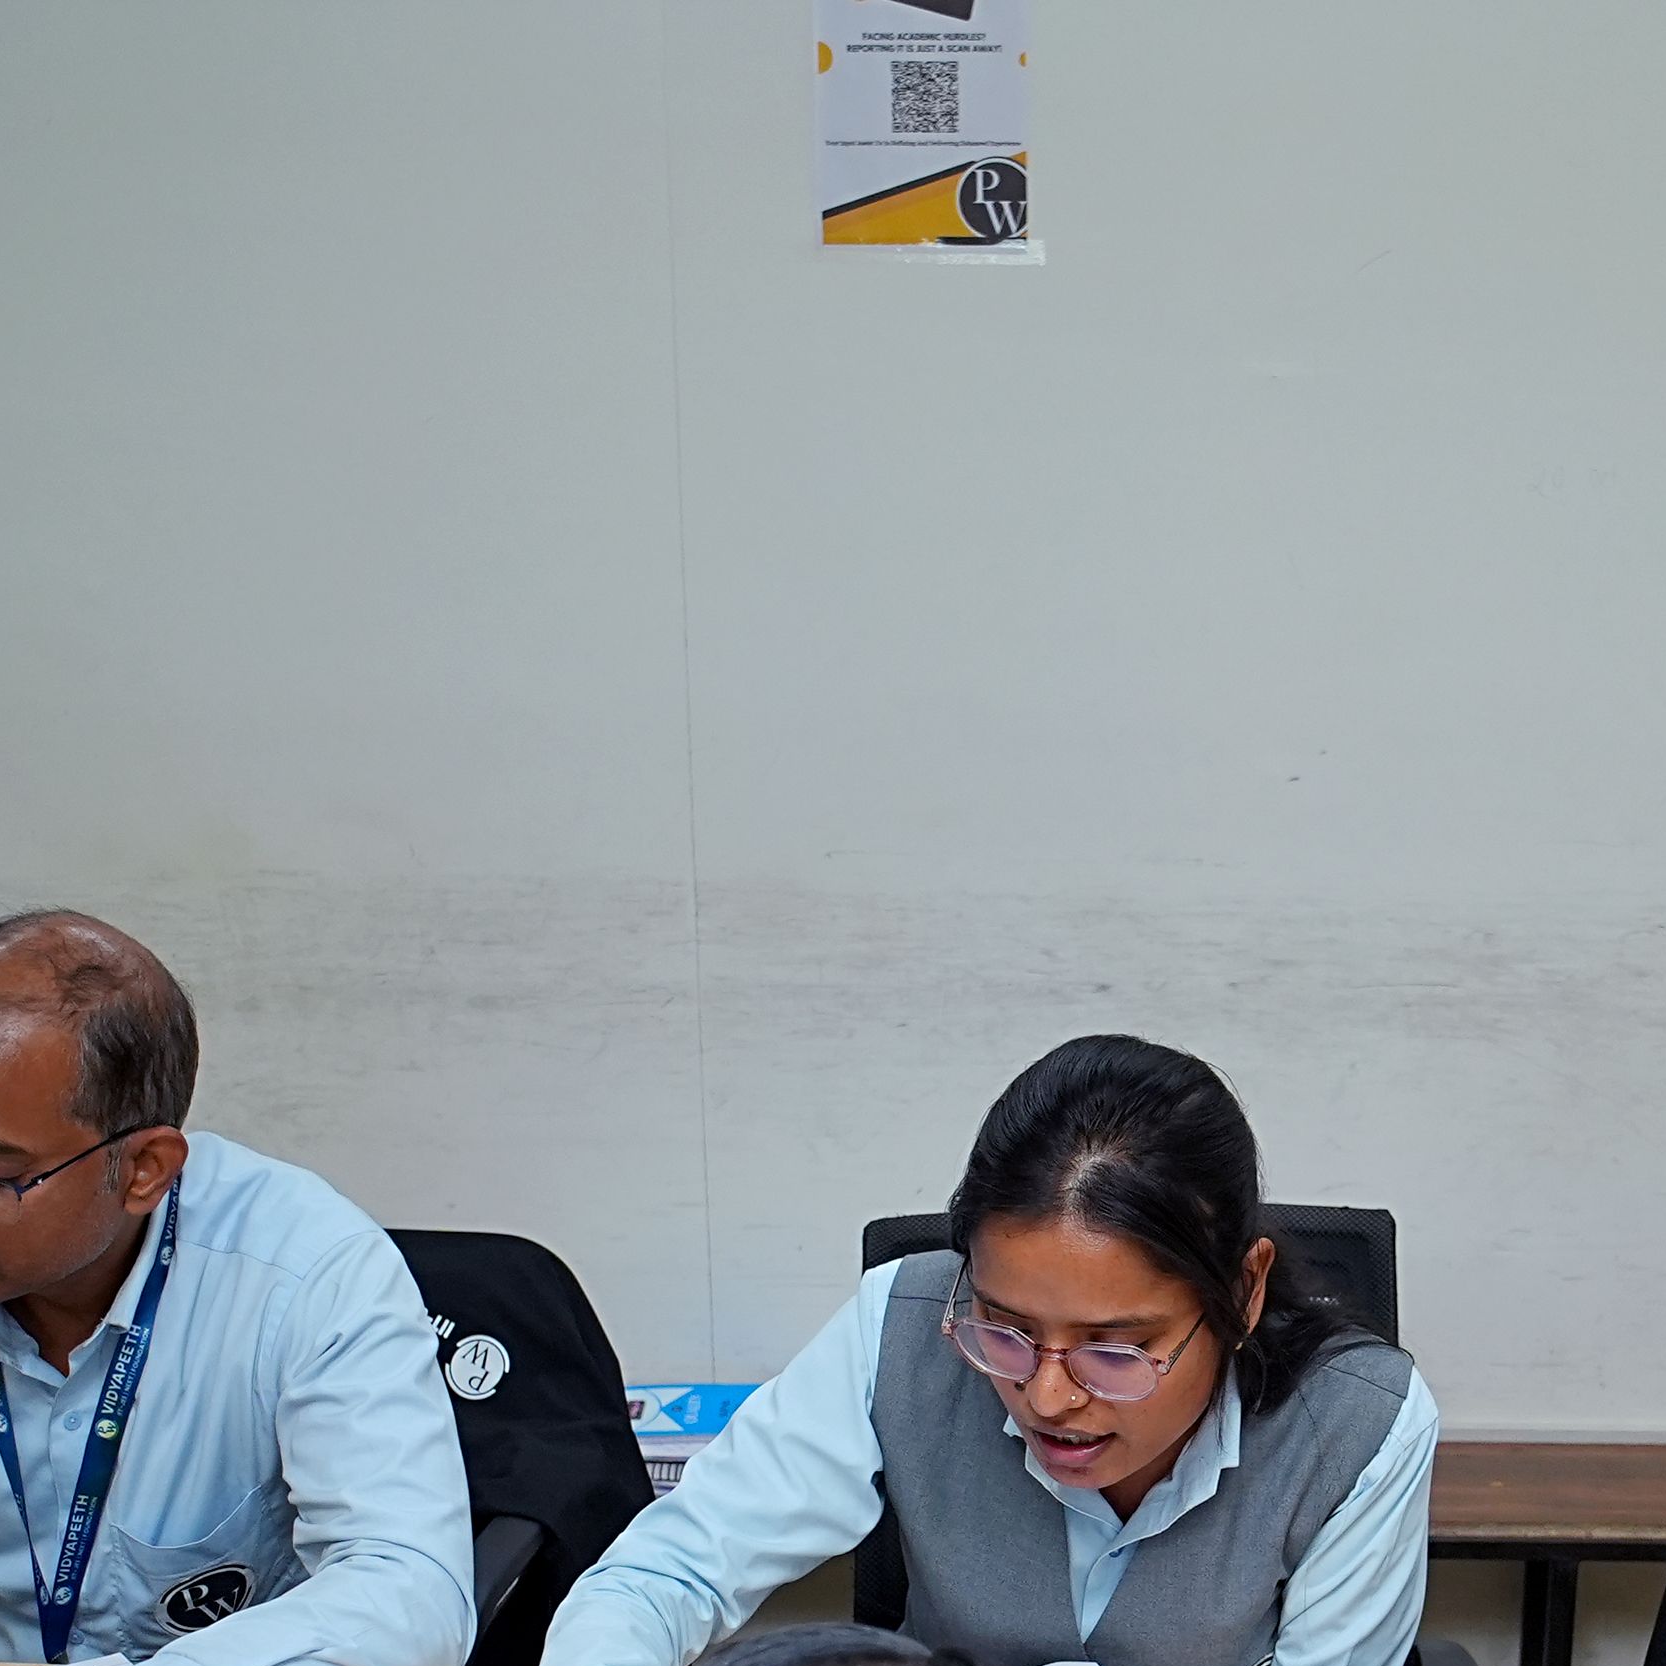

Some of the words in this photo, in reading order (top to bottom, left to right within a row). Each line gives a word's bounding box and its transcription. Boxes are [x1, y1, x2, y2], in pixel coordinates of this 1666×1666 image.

[847, 45, 895, 53] REPORTING
[916, 45, 937, 53] JUST
[946, 45, 971, 53] SCAN
[897, 33, 941, 41] ACADEMIC
[973, 169, 1027, 235] PW
[165, 1179, 179, 1239] VIDYAP
[101, 1325, 142, 1414] VIDYAPEETH
[131, 1328, 149, 1372] FOUNDATION
[462, 1341, 490, 1392] PW
[57, 1495, 89, 1582] VIDYAPEETH
[180, 1584, 240, 1621] PW
